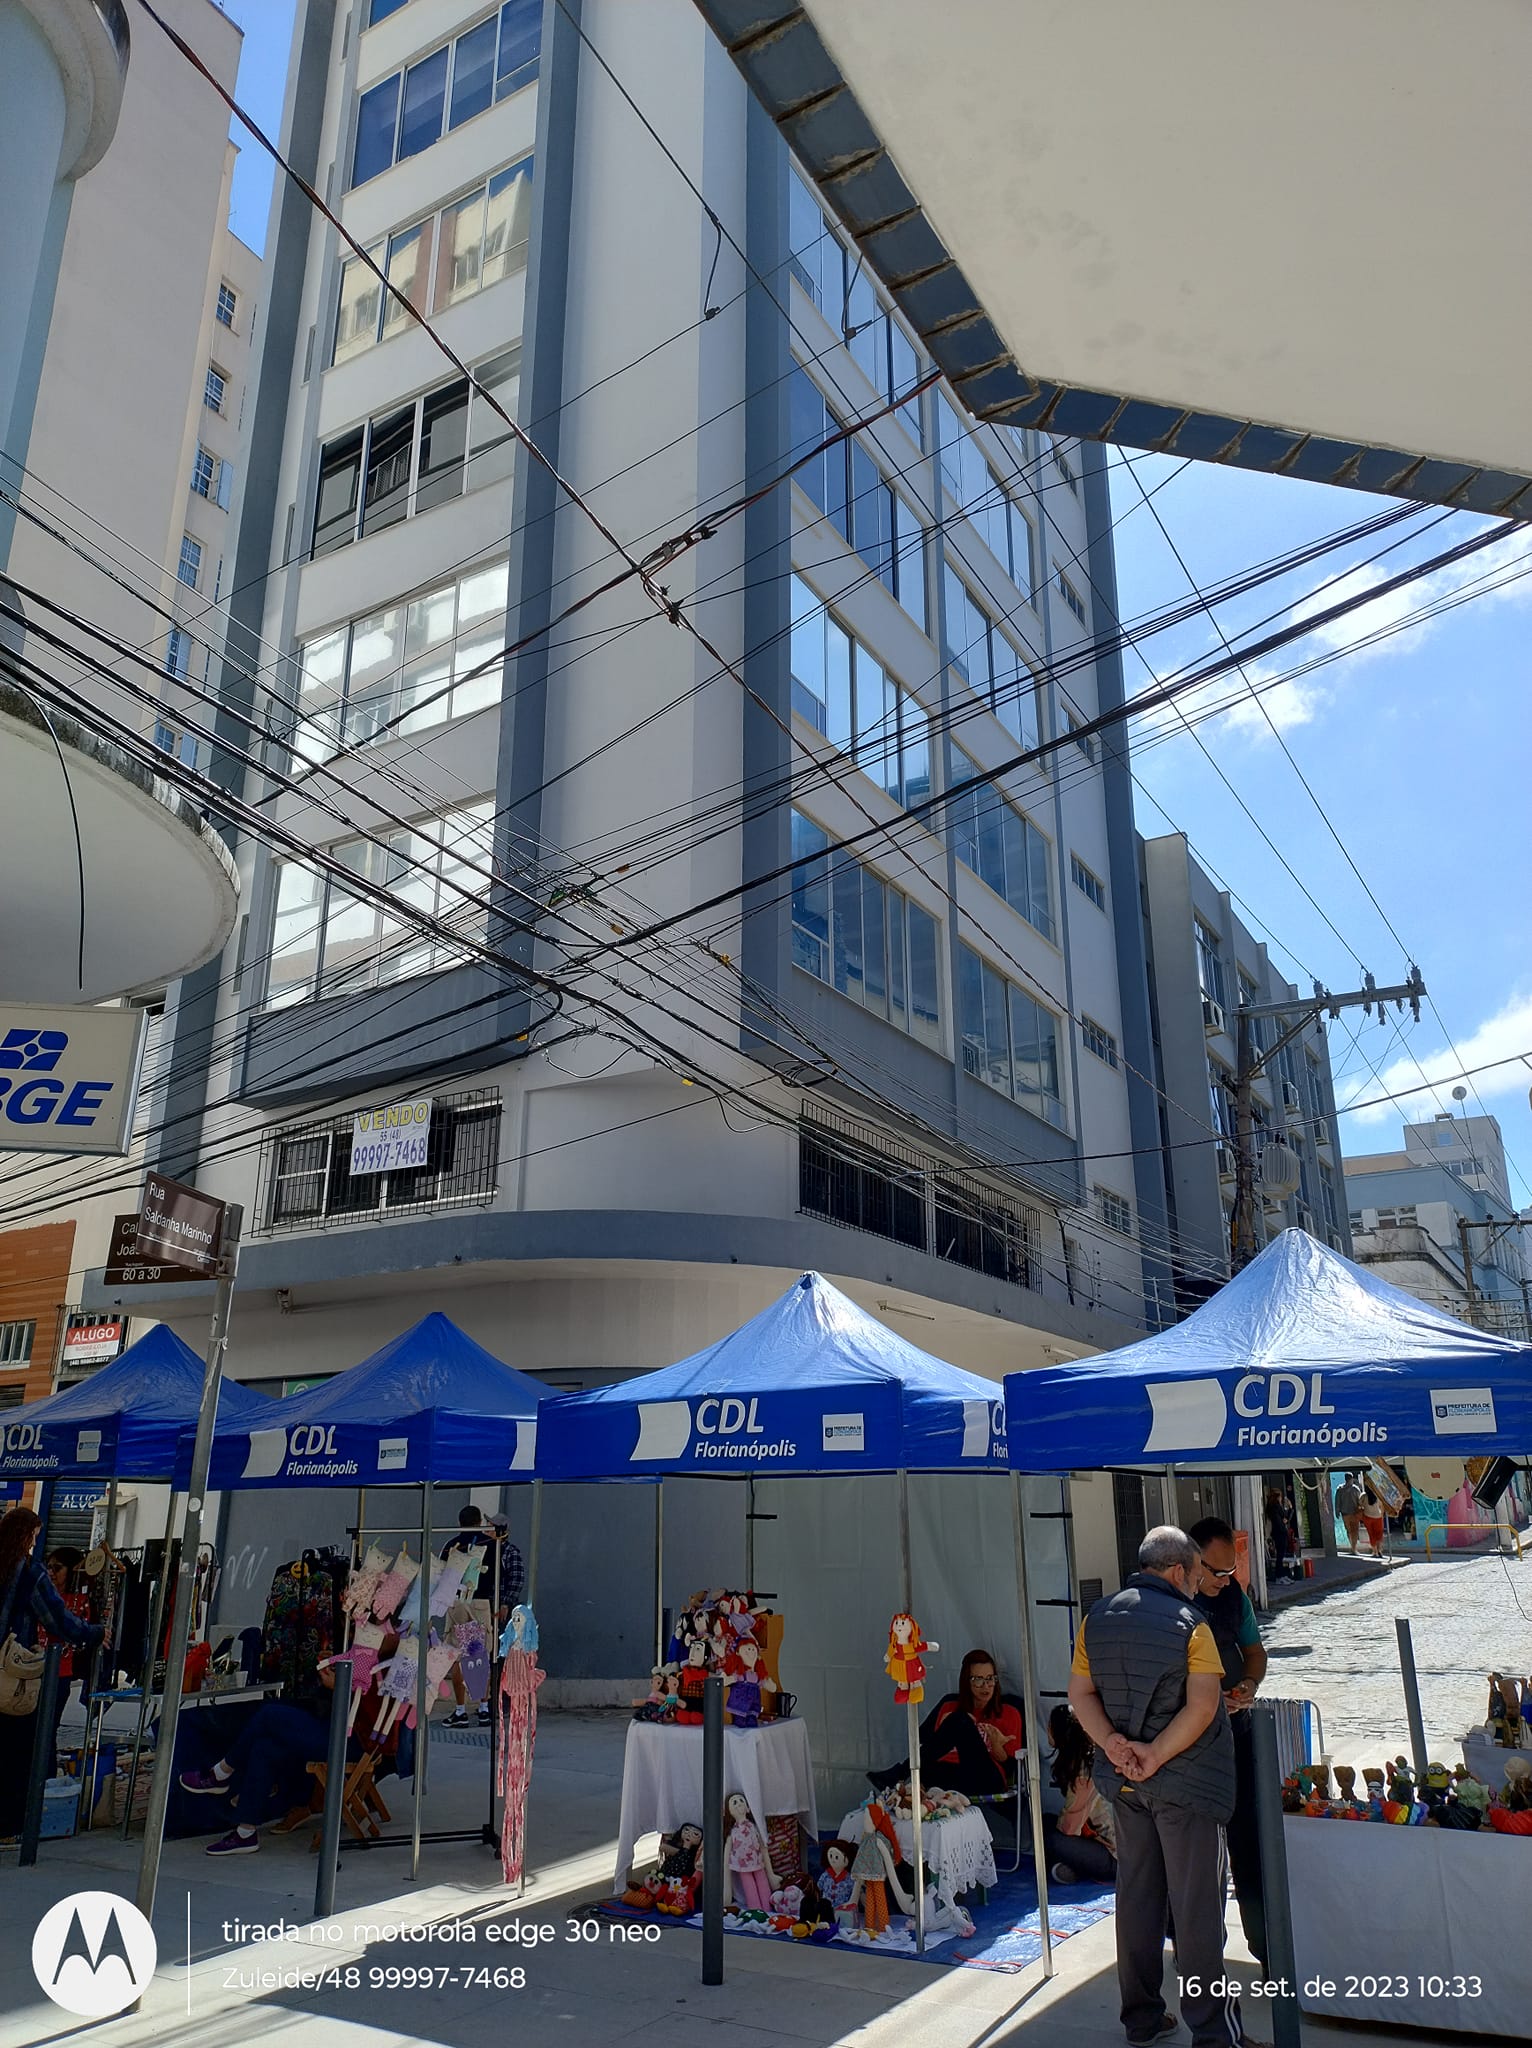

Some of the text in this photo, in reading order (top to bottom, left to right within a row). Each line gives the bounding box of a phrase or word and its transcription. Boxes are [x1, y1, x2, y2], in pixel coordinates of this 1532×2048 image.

[358, 1102, 429, 1133] VENDO
[353, 1137, 426, 1172] 99997-7468
[149, 1181, 165, 1201] Rua
[144, 1206, 180, 1233] Saldanha
[181, 1221, 213, 1245] Marinho
[122, 1267, 161, 1281] 60 a 30
[72, 1327, 115, 1344] ALUGO
[1233, 1373, 1335, 1418] CDL
[696, 1398, 764, 1435] CDL
[6, 1424, 43, 1451] CDL
[289, 1425, 338, 1456] CDL
[1237, 1421, 1388, 1448] Florianópolis
[2, 1455, 60, 1470] Florianópolis
[694, 1439, 797, 1461] Florianópolis
[286, 1460, 359, 1478] Florianópolis
